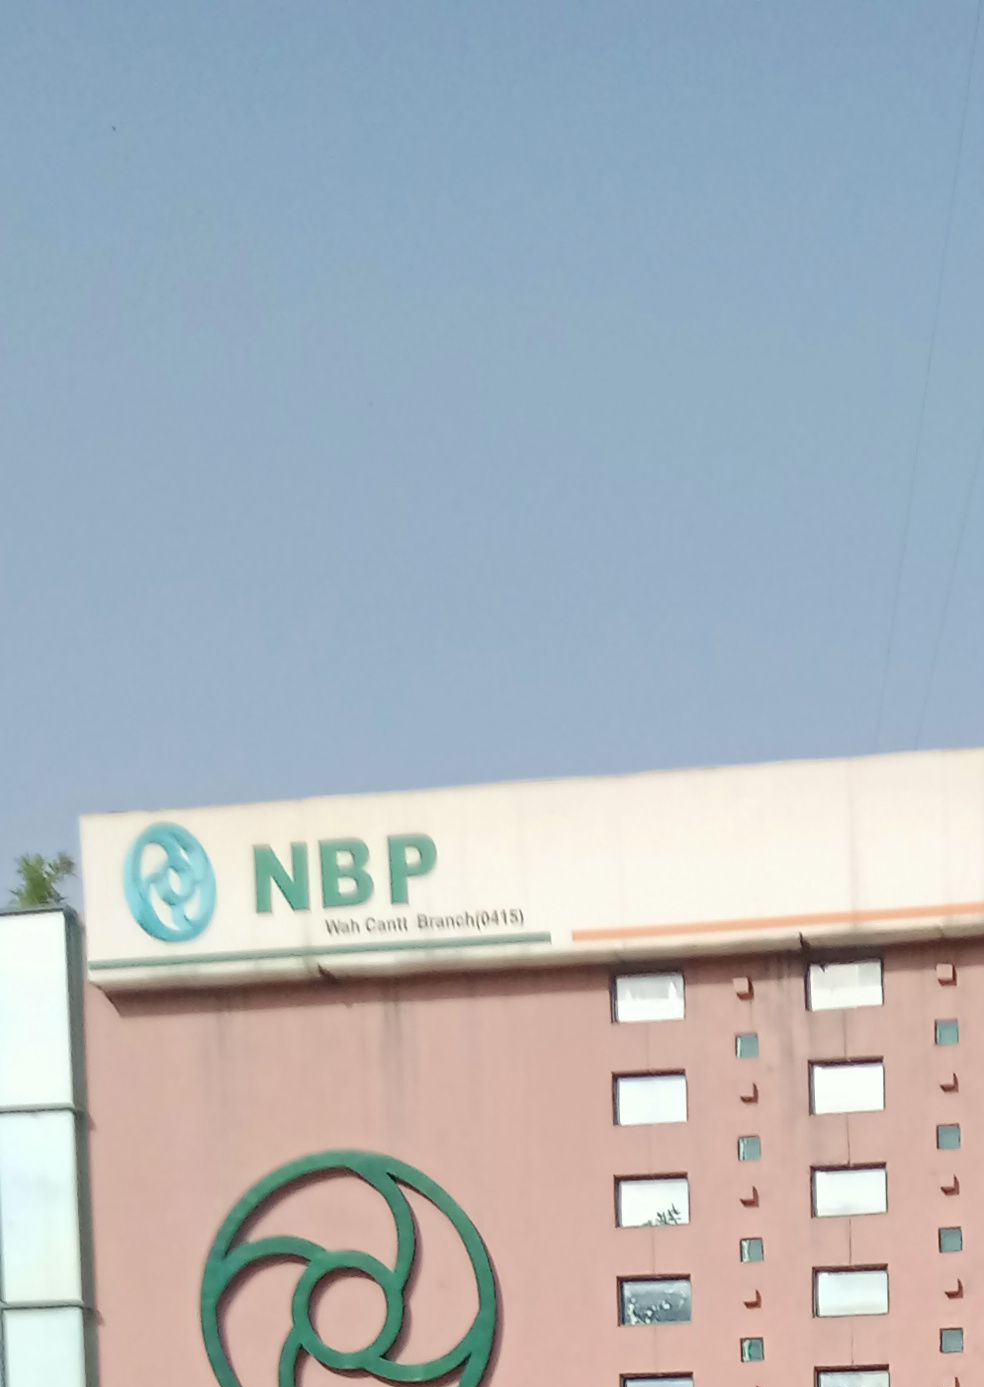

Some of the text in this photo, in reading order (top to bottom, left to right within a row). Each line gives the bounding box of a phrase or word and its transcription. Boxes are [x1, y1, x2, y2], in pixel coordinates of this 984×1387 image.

[252, 832, 438, 915] NBP
[325, 918, 361, 935] Wah
[365, 916, 409, 933] Cantt
